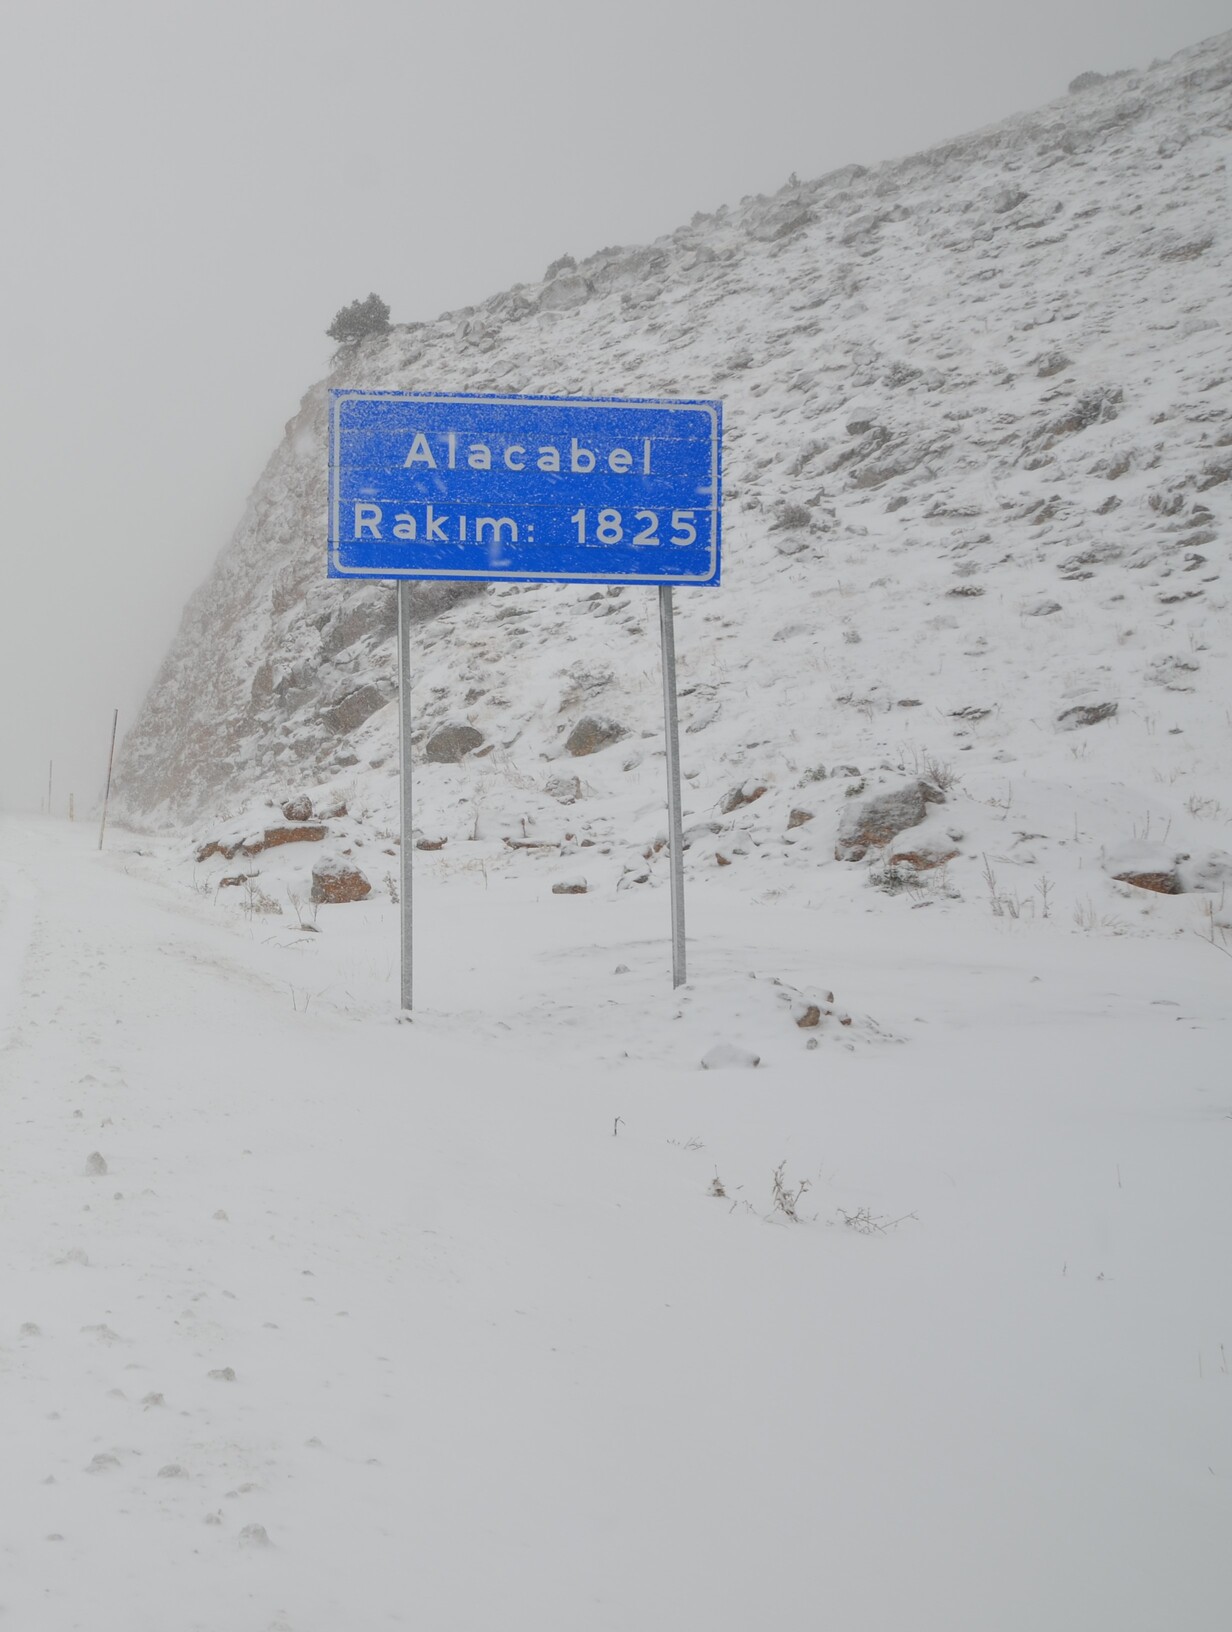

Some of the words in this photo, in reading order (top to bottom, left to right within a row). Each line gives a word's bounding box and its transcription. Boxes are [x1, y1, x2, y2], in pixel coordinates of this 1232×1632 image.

[404, 432, 651, 475] Alacabel
[354, 503, 535, 543] Rakım:
[571, 508, 698, 546] 1825
